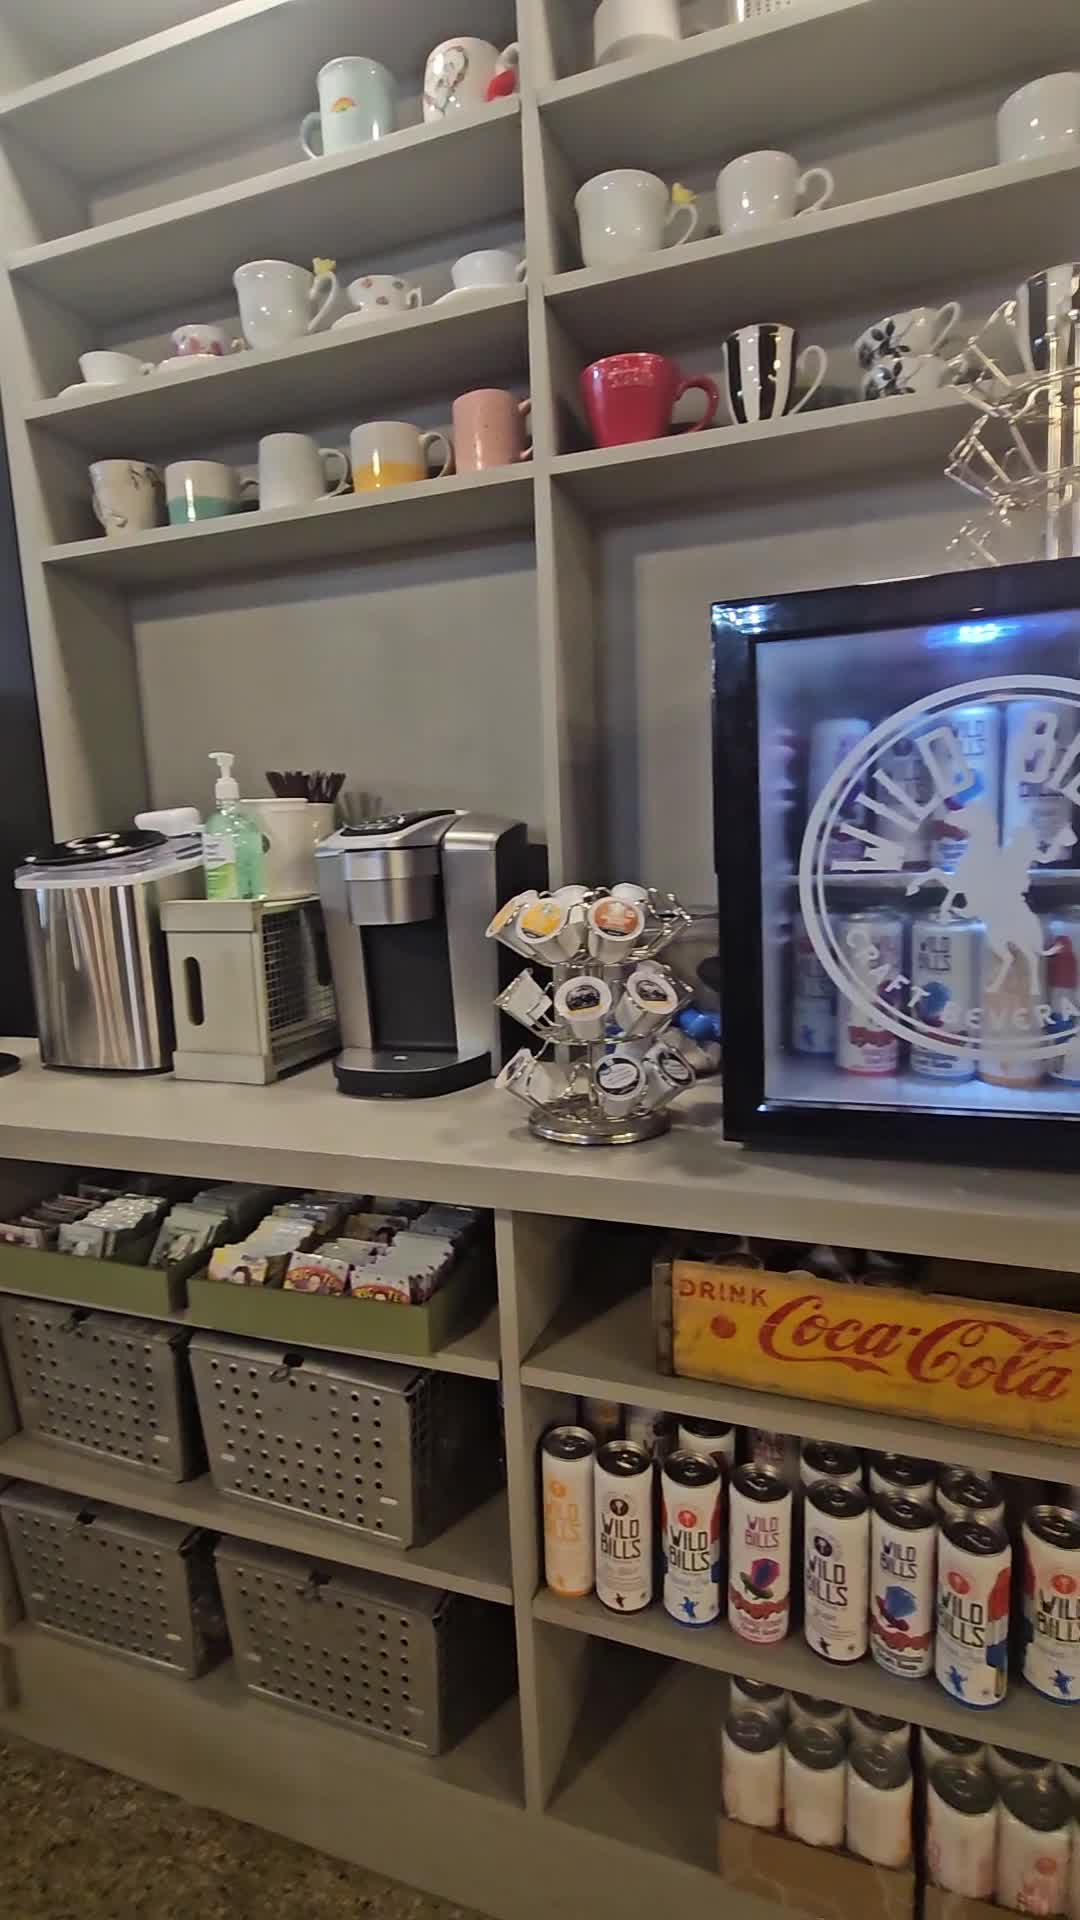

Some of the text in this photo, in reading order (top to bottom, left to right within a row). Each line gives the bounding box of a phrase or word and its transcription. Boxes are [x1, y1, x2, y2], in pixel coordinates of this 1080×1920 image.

[830, 708, 1080, 871] WILD BI
[845, 928, 931, 1008] CRAFT
[677, 1279, 769, 1307] DRINK
[758, 1294, 1074, 1401] Coca-Cola
[600, 1512, 640, 1539] WILD
[746, 1513, 779, 1533] WILD
[600, 1531, 641, 1560] BILLS
[669, 1524, 708, 1552] WILD
[745, 1528, 780, 1549] BILLS
[882, 1535, 917, 1563] WILD
[668, 1544, 710, 1572] BILLS
[807, 1550, 846, 1585] WILD
[1038, 1588, 1080, 1621] WIL
[1036, 1610, 1080, 1643] BILL
